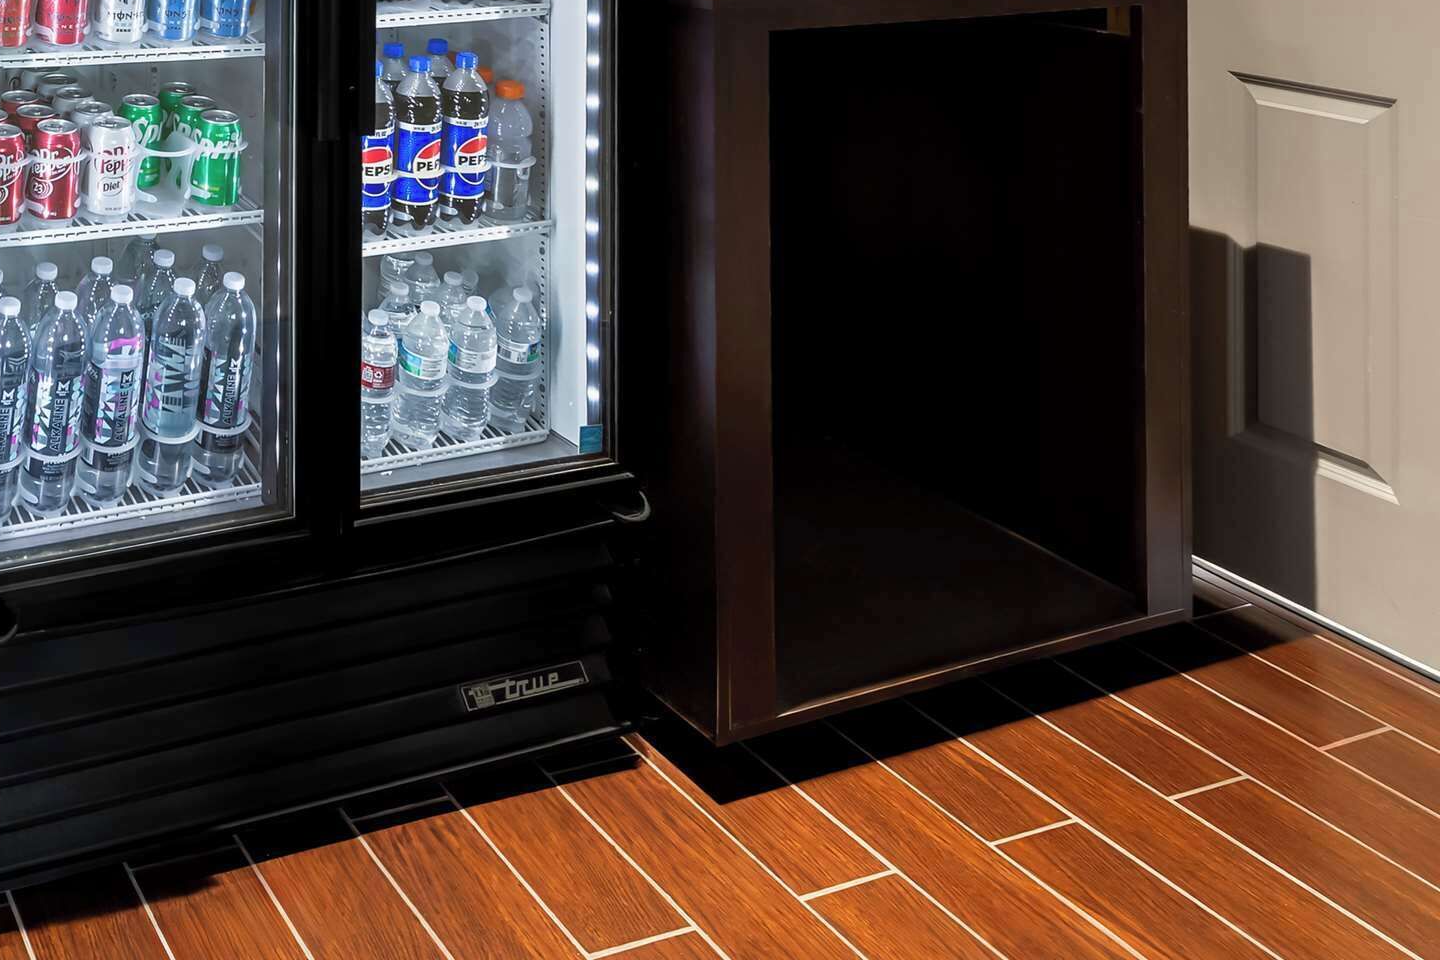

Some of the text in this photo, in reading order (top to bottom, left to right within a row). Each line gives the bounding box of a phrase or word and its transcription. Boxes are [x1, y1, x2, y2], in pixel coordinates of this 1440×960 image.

[364, 165, 390, 176] EPS
[416, 159, 440, 171] PEP
[102, 180, 121, 193] Diet
[115, 389, 129, 441] ALKALINE
[223, 373, 237, 425] ALKALINE
[50, 398, 66, 454] ALKALINE
